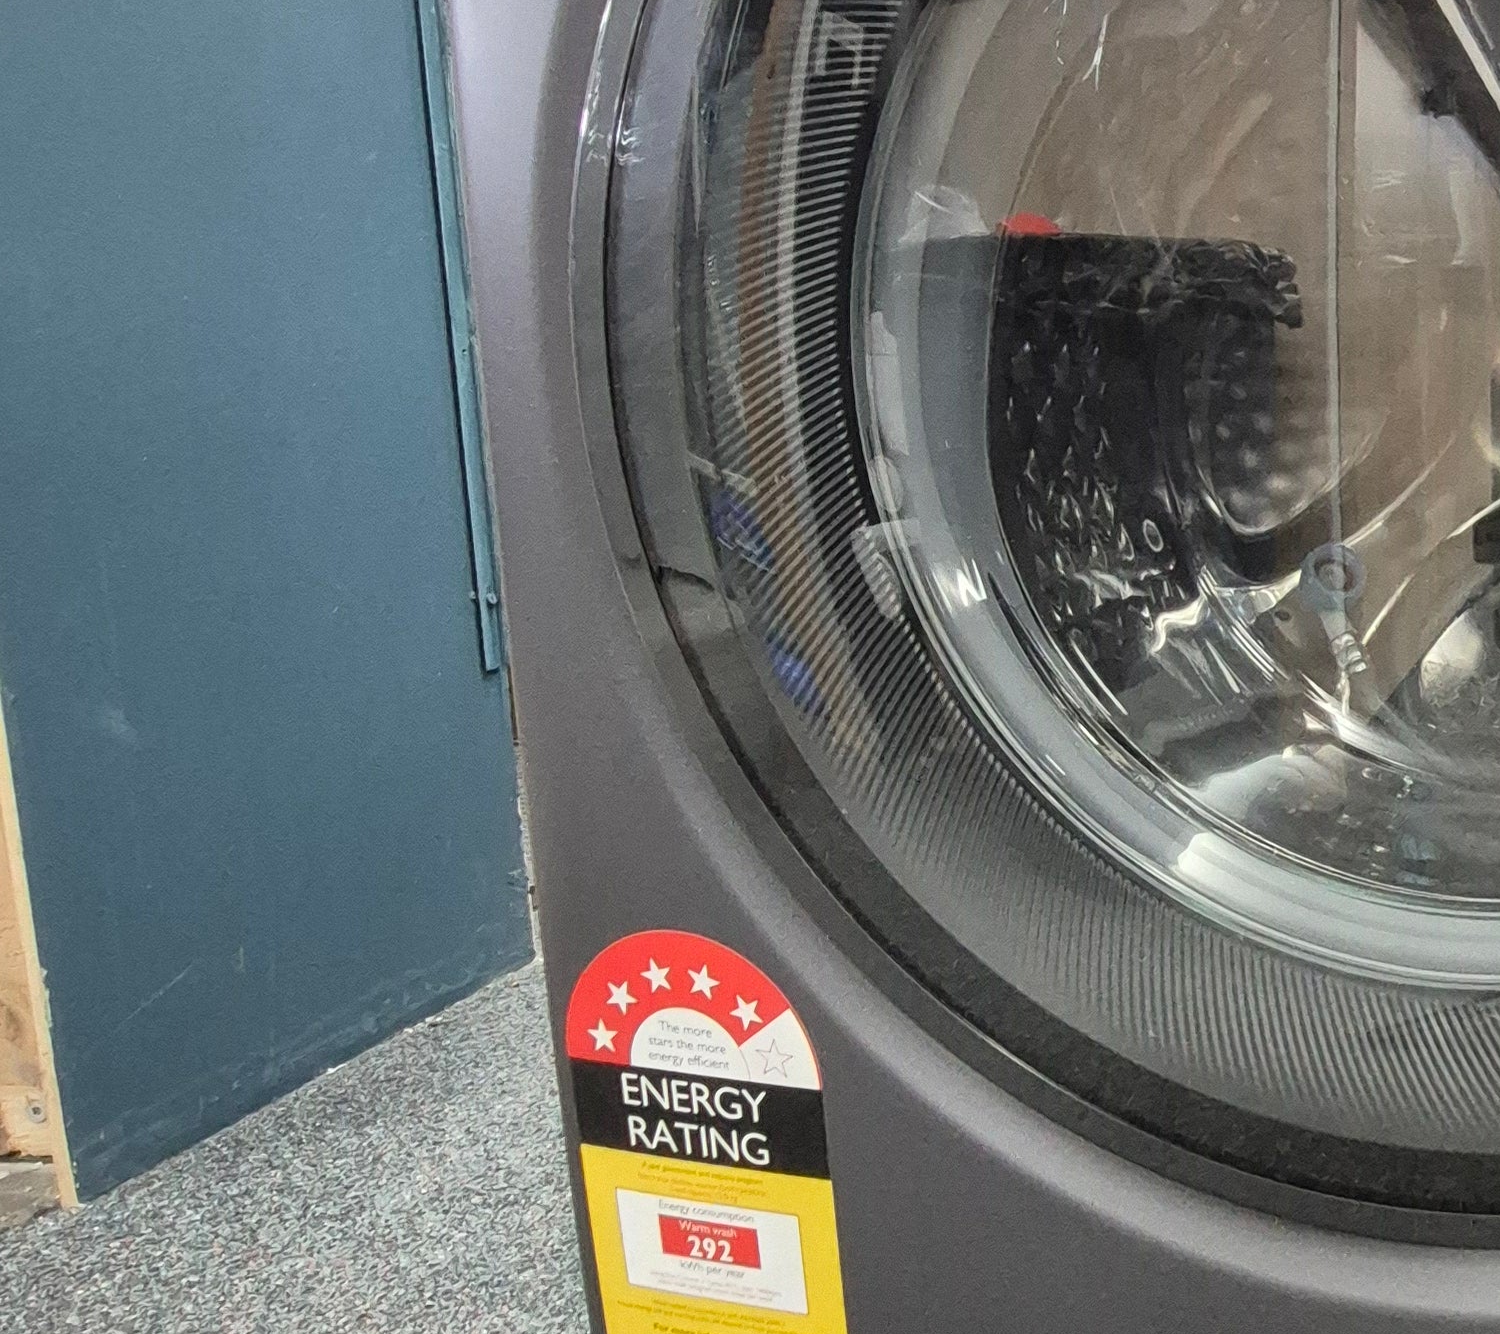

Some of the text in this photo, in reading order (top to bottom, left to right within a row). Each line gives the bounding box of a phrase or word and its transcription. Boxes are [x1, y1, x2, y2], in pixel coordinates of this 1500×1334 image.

[658, 1020, 712, 1038] The more
[649, 1037, 726, 1054] stars the more
[649, 1052, 729, 1070] energy efficient
[620, 1072, 767, 1124] ENERGY
[627, 1115, 770, 1165] RATING
[658, 1198, 690, 1215] Energy
[679, 1219, 737, 1238] Warm wash
[687, 1235, 734, 1262] 292
